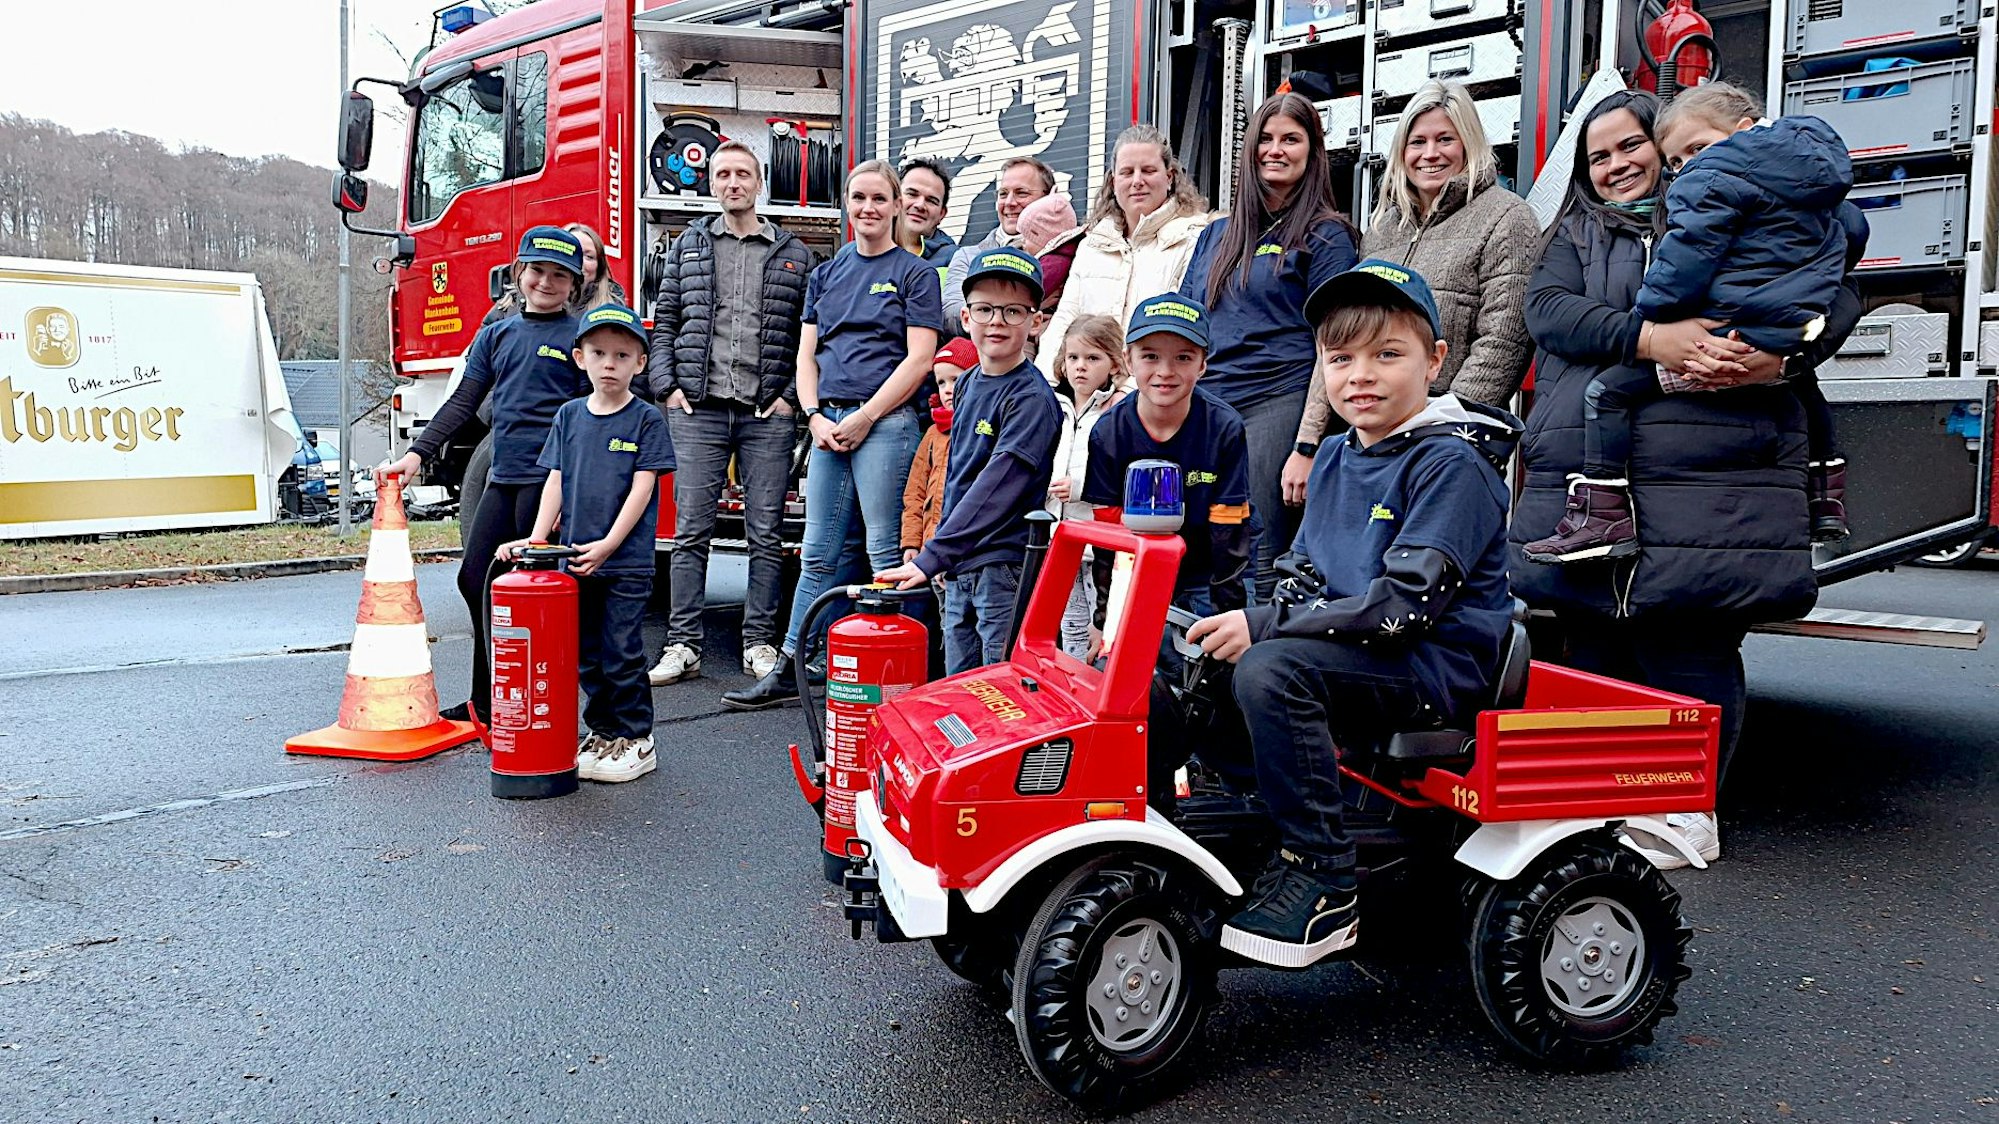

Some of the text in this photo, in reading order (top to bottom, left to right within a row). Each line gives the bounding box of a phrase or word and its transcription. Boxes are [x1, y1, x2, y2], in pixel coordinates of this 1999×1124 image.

[427, 293, 455, 306] Gemeinde
[424, 306, 460, 319] Blankenheim
[428, 322, 455, 332] Feuerwehr
[88, 335, 112, 344] 1817
[68, 365, 161, 394] Bitte ein Bit
[960, 679, 1027, 723] FEUERWEHR
[1675, 709, 1700, 722] 112
[1614, 771, 1695, 786] FEUERWEHR
[1451, 784, 1479, 815] 112
[956, 807, 979, 837] 5
